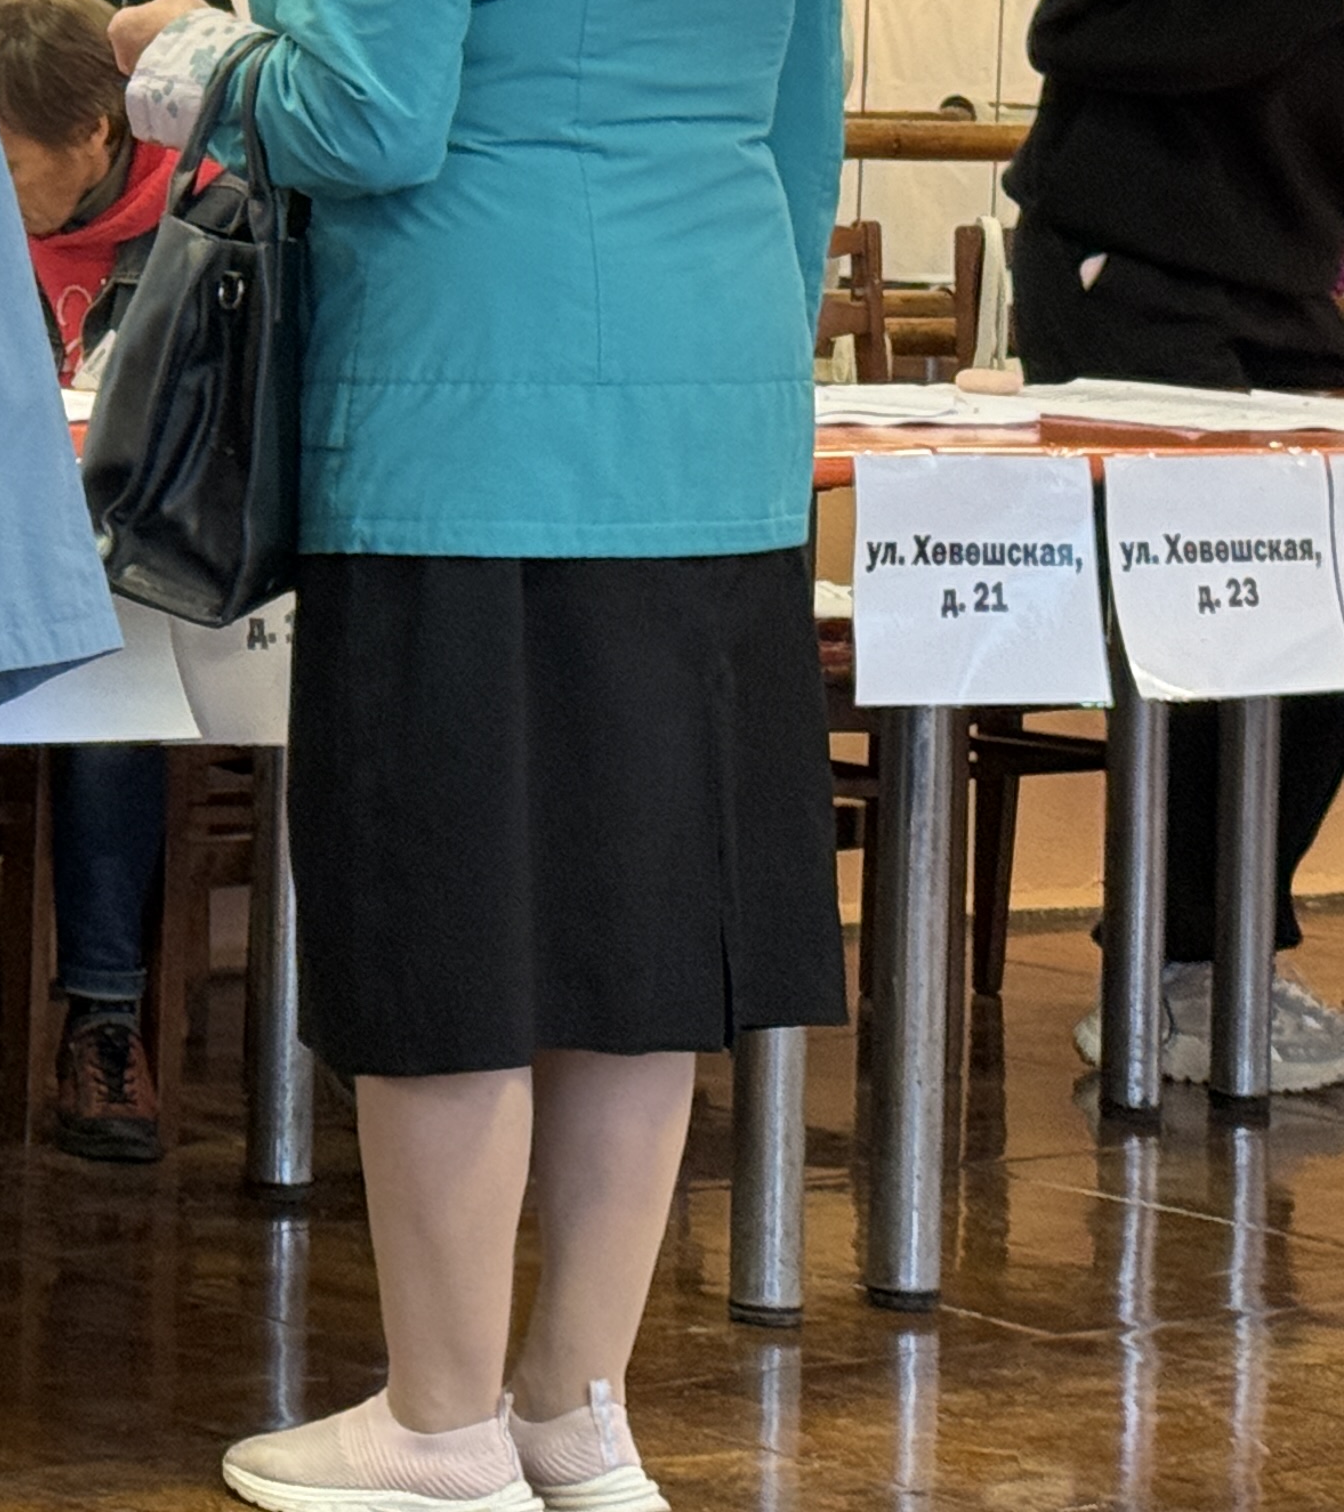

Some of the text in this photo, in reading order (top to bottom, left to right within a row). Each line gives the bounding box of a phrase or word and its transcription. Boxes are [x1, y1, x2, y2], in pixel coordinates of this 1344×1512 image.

[865, 534, 1083, 574] ул. Хевешская,
[1119, 533, 1322, 572] ул. Хевешская,
[941, 581, 1009, 619] д. 21
[1198, 577, 1260, 615] д. 23
